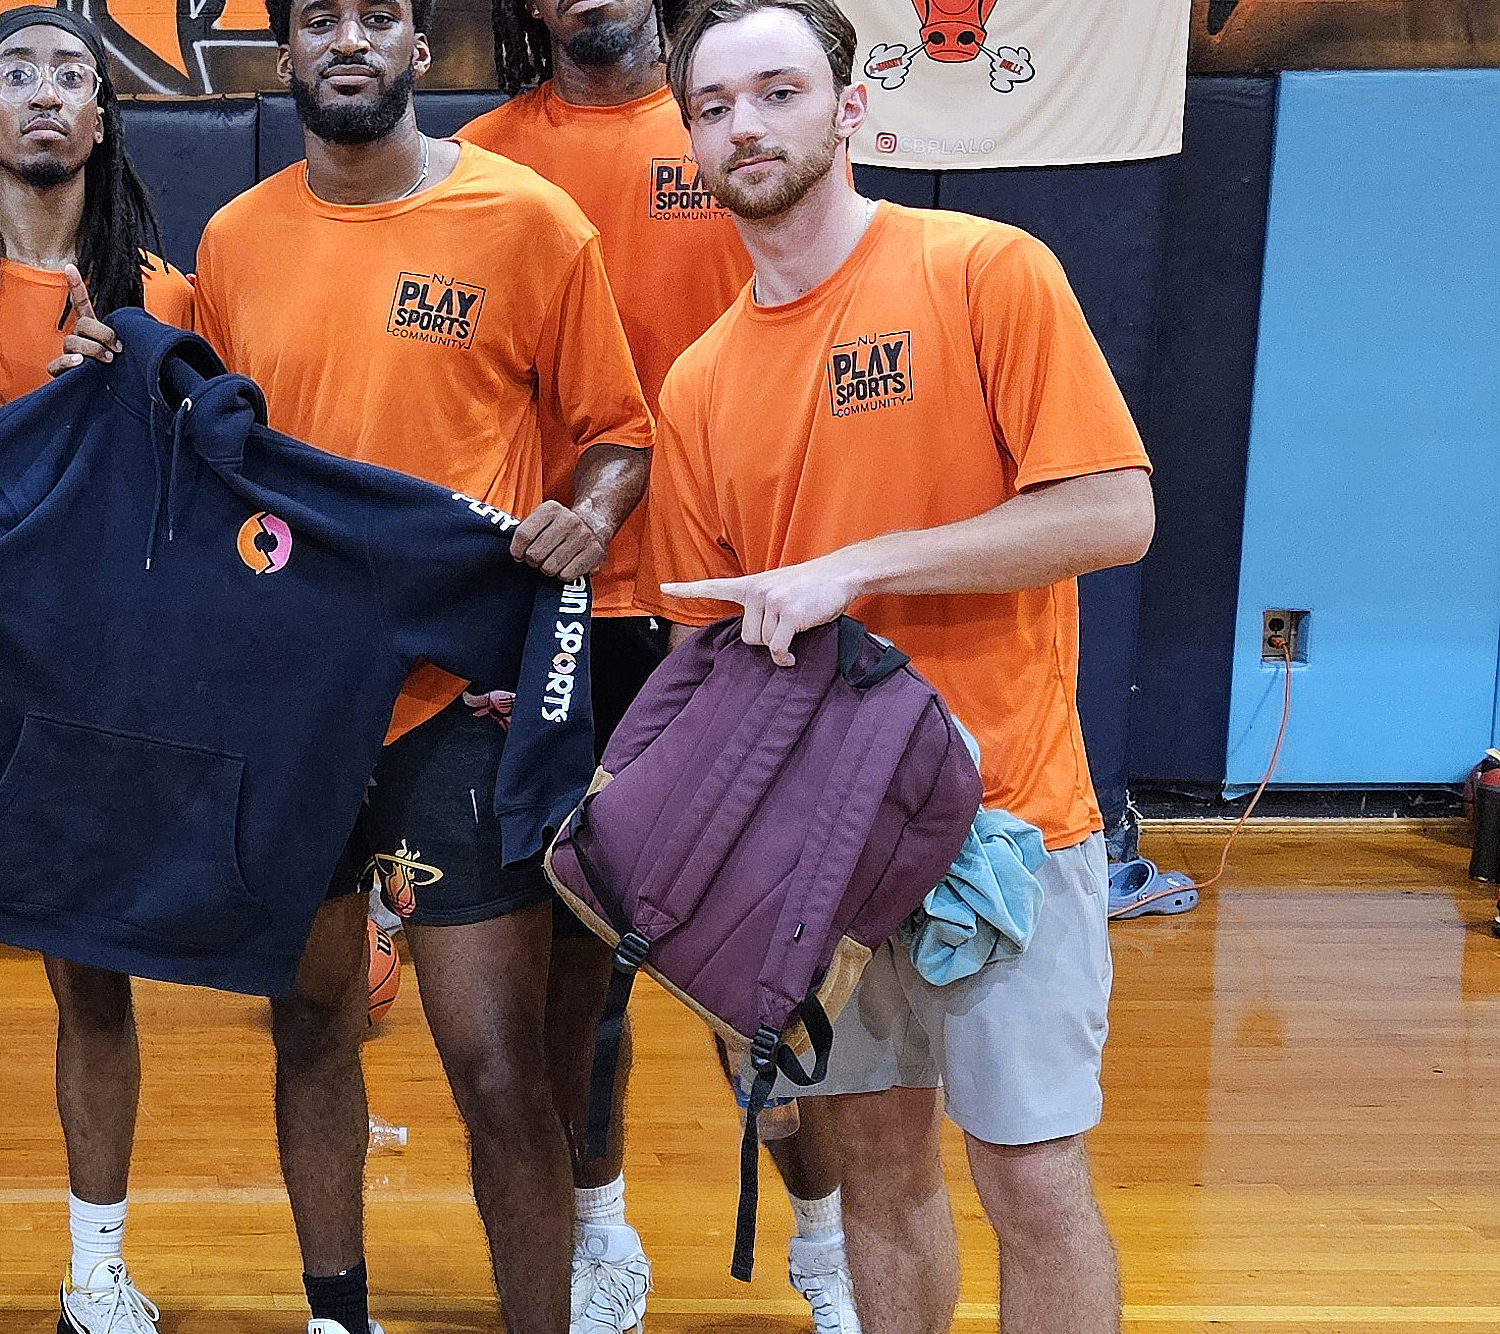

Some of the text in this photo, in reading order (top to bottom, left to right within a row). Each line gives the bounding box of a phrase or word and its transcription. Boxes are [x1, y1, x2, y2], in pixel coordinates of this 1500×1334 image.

[899, 136, 997, 155] CBPLALO
[655, 211, 727, 221] COMMUNITY
[432, 273, 455, 286] NJ
[398, 281, 478, 319] PLAY
[394, 308, 471, 339] SPORTS
[392, 328, 466, 349] COMMUNITY
[857, 333, 877, 346] NJ
[833, 340, 904, 385] PLAY
[836, 372, 906, 406] SPORTS
[837, 396, 907, 417] COMMUNITY
[541, 620, 585, 723] SPORTS
